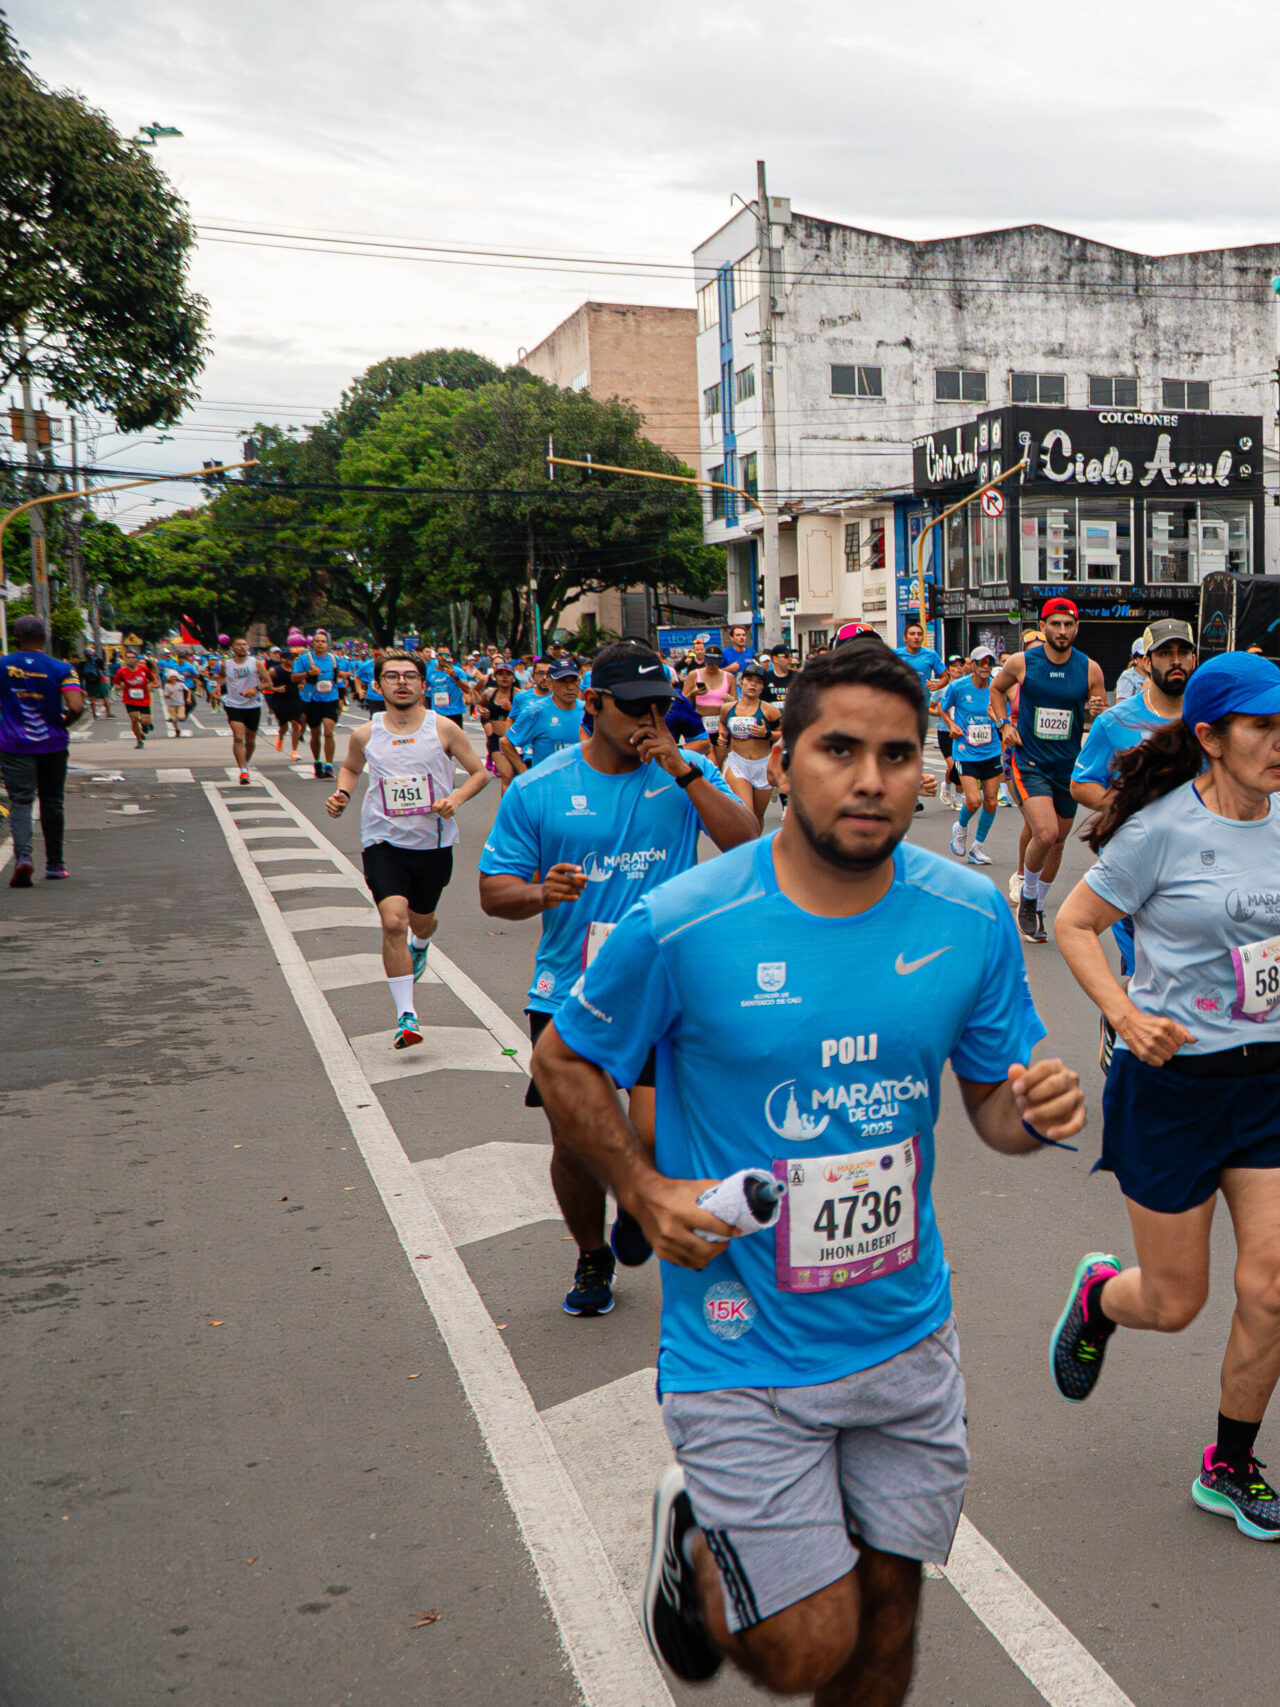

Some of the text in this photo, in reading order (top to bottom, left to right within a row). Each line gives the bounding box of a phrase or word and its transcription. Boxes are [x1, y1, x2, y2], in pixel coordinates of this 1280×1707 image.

[1099, 412, 1179, 428] COLCHONES
[1041, 429, 1233, 488] Cielo Azul
[1039, 717, 1069, 730] 10226
[391, 786, 423, 802] 7451
[603, 848, 667, 868] MARATÓN
[619, 861, 649, 872] DE CALI
[1265, 905, 1275, 914] DE
[1194, 997, 1220, 1012] 15K
[821, 1032, 878, 1068] POLI
[811, 1075, 930, 1111] MARATÓN
[848, 1102, 900, 1123] DE CALI
[860, 1121, 894, 1137] 2025
[813, 1185, 902, 1242] 4736
[819, 1231, 897, 1262] JHON ALBERT
[707, 1299, 749, 1321] 15K
